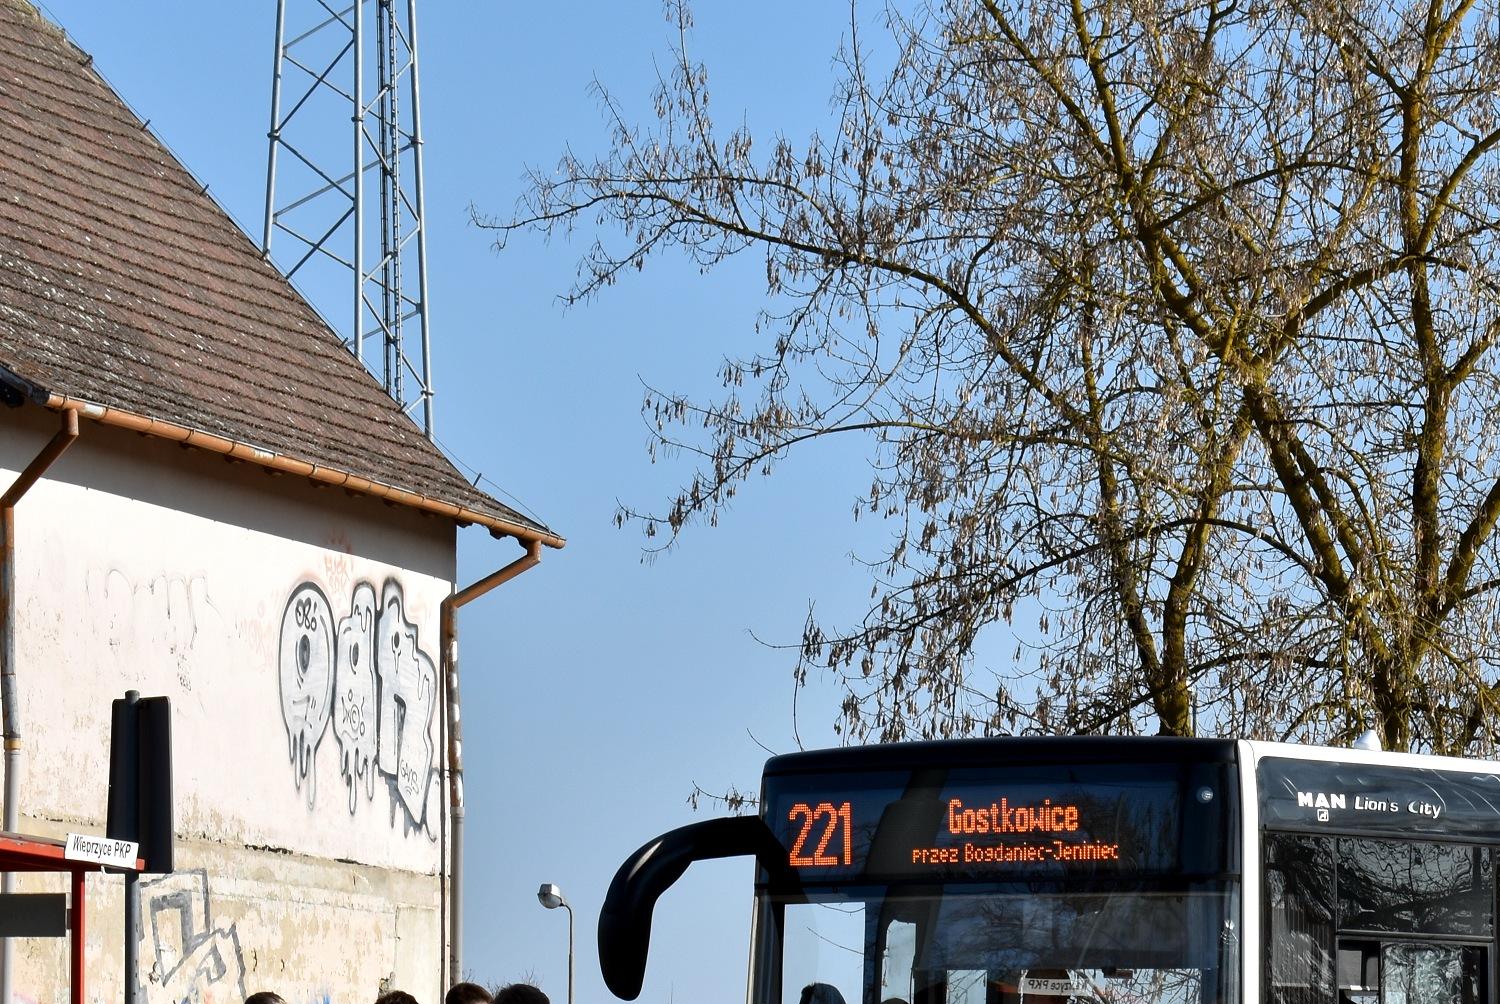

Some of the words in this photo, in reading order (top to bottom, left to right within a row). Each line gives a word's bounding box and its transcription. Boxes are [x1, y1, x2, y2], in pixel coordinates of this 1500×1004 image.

[949, 798, 1079, 834] Gostkowice
[1297, 791, 1346, 809] MAN
[1355, 796, 1398, 812] Lion's
[1408, 800, 1441, 819] City
[72, 835, 112, 859] Wieprzyce
[114, 841, 132, 858] PKP
[788, 801, 851, 866] 221
